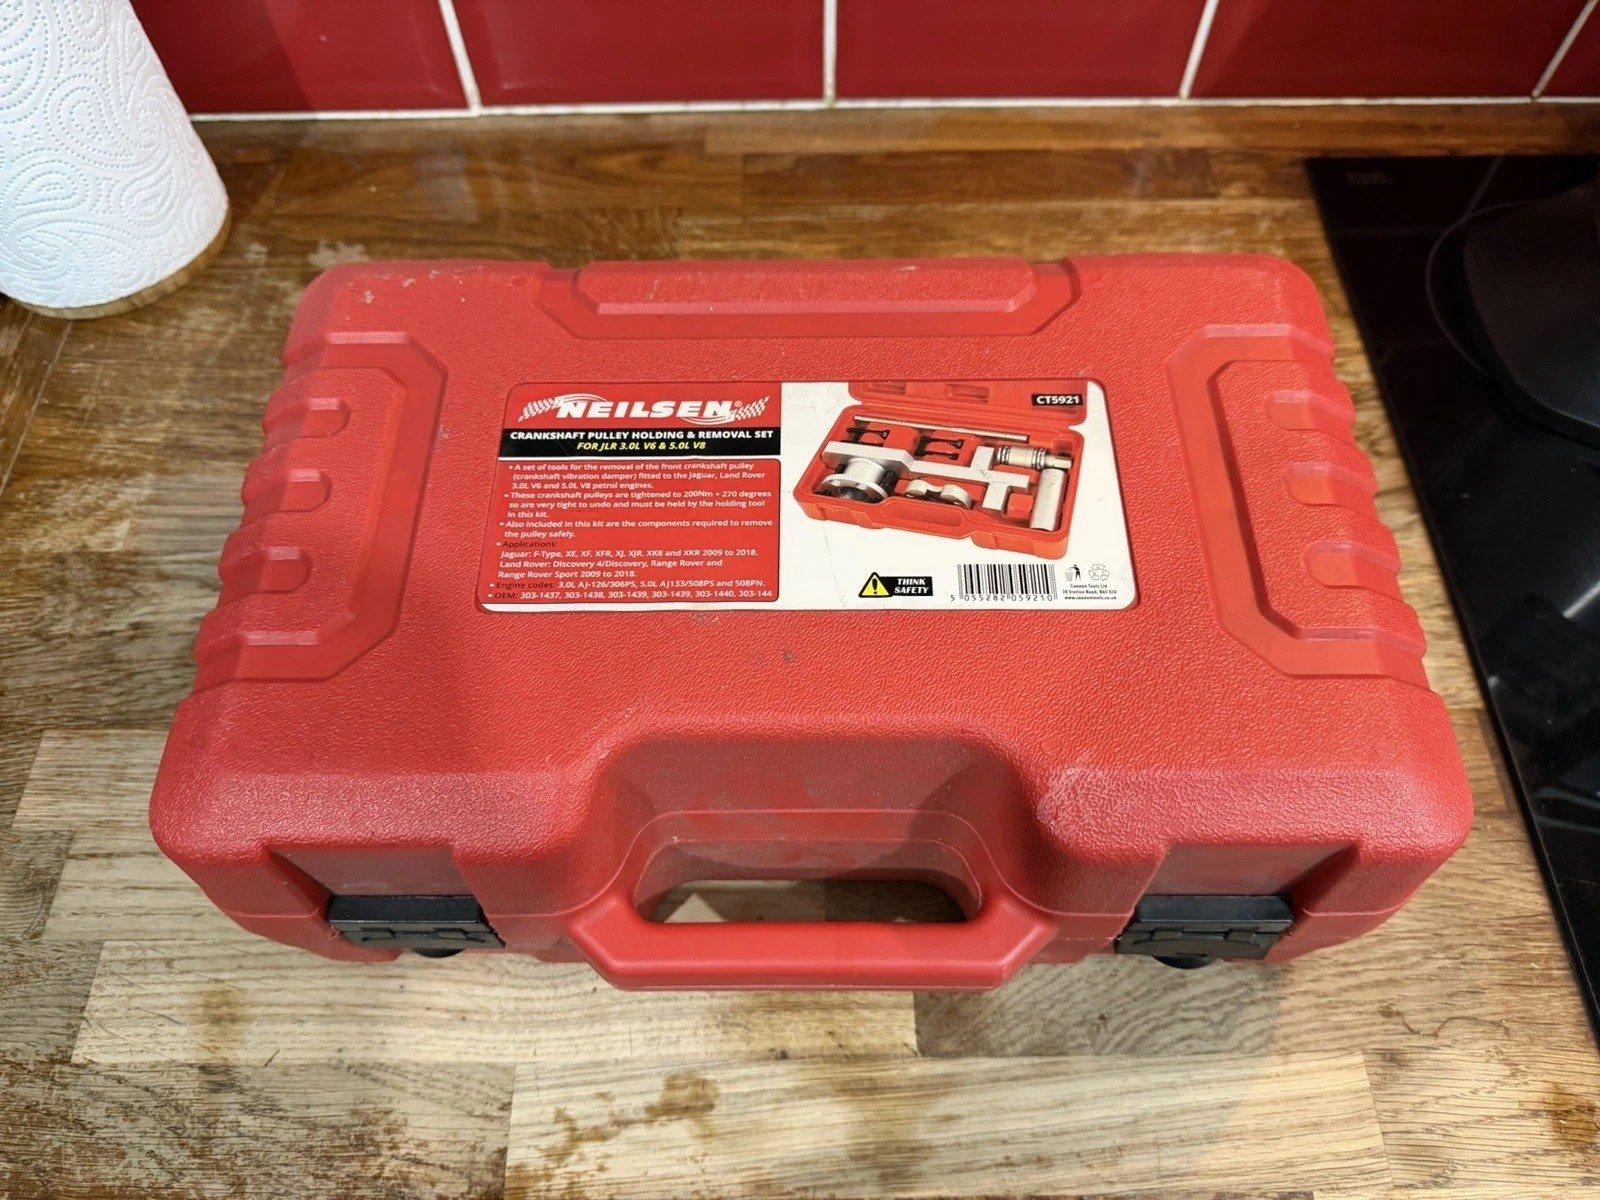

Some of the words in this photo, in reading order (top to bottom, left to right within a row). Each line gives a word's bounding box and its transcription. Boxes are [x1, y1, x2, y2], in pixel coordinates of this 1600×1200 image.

[1036, 395, 1079, 404] CT5921
[510, 432, 585, 440] CRANKSHAFT
[577, 442, 598, 450] FOR
[598, 442, 617, 452] JLR
[619, 442, 640, 450] 3.0L
[729, 463, 754, 471] pulley
[688, 472, 717, 480] Jaguar,
[592, 482, 618, 490] petrol
[620, 482, 654, 490] engines.
[583, 492, 613, 500] pulleys
[683, 490, 713, 498] 200Nm
[739, 490, 772, 498] degrees
[687, 500, 698, 508] by
[715, 500, 746, 508] holding
[638, 520, 690, 528] components
[692, 520, 728, 528] required
[520, 531, 546, 539] pulley
[502, 541, 558, 549] Applications:
[553, 560, 594, 569] Discovery
[651, 560, 678, 568] Range
[498, 571, 525, 579] Range
[554, 571, 578, 579] Sport
[496, 582, 527, 590] Engine
[520, 592, 562, 600] 303-1437,
